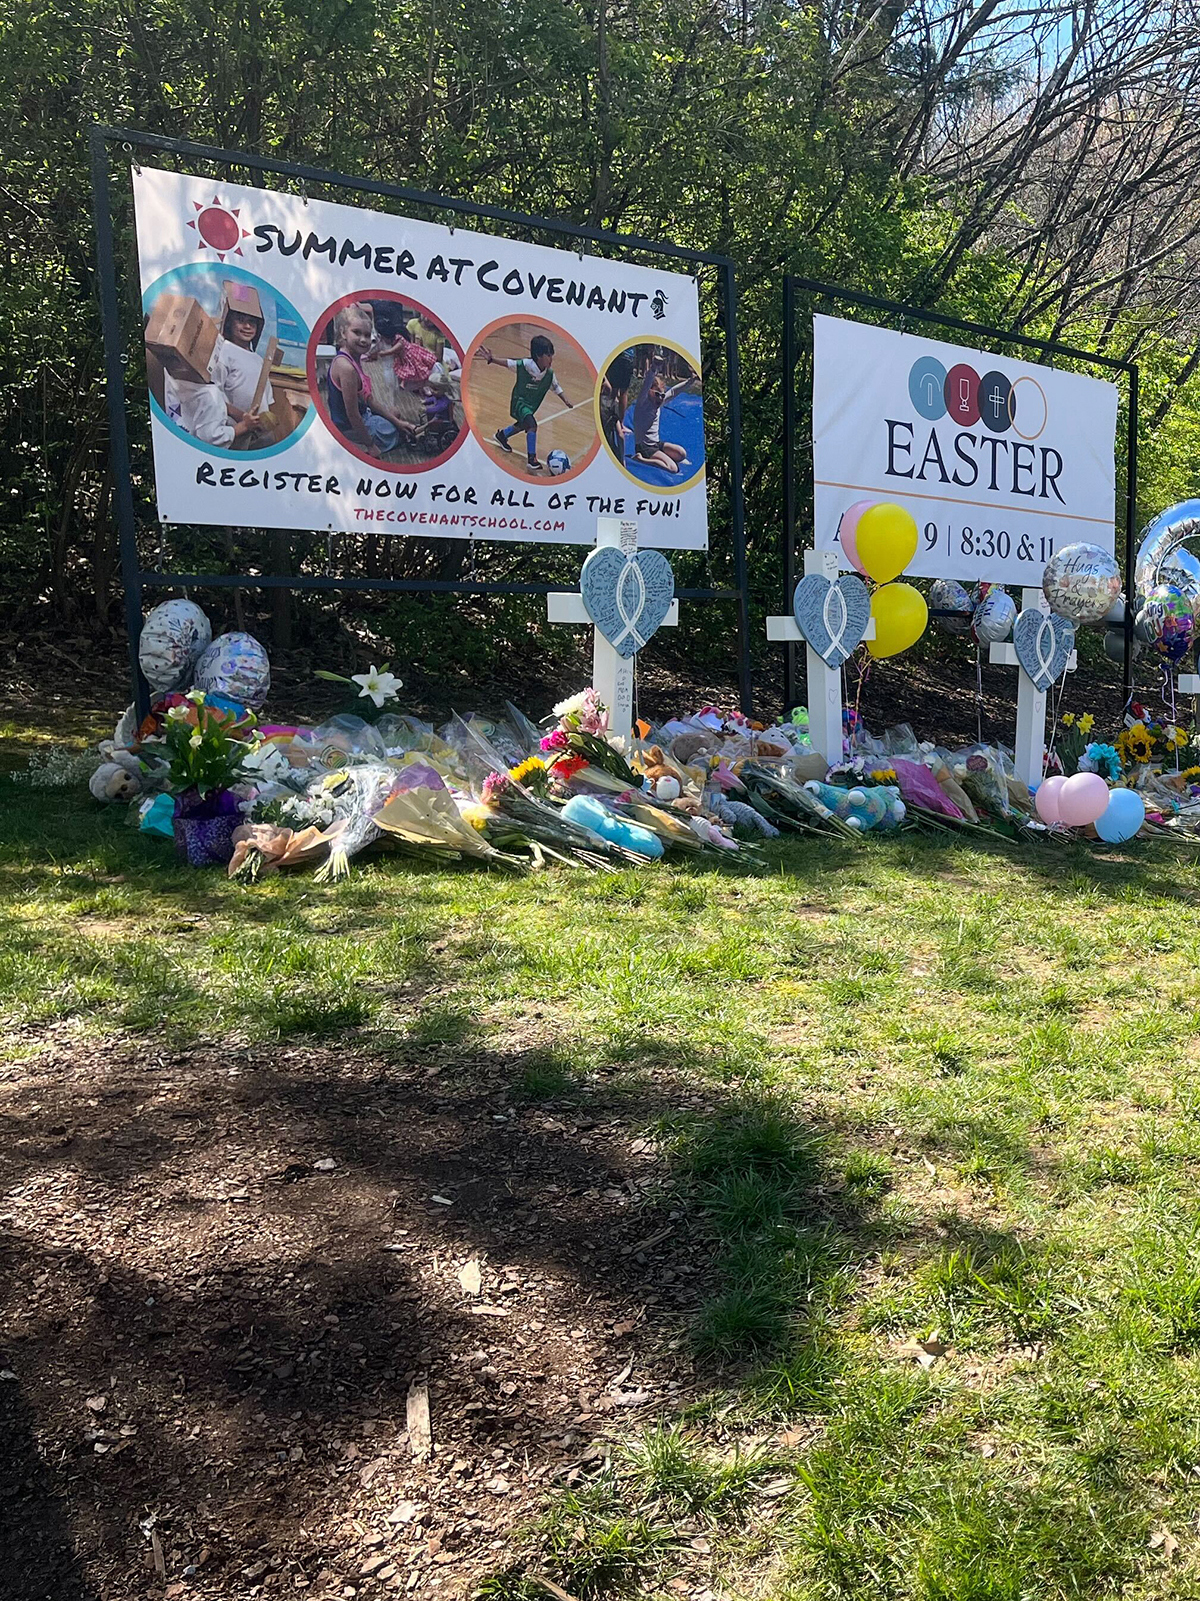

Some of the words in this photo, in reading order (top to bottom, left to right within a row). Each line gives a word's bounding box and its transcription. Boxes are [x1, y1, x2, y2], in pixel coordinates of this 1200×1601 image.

[254, 225, 418, 280] SUMMER
[426, 255, 474, 285] AT
[477, 260, 648, 317] COVENANT
[884, 419, 1067, 505] EASTER
[196, 462, 340, 495] REGISTER
[356, 478, 417, 500] NOW
[431, 484, 477, 505] FOR
[490, 489, 535, 508] ALL
[549, 493, 576, 511] OF
[586, 495, 625, 515] THE
[637, 499, 681, 519] FUN!
[354, 508, 565, 531] THECOVENANTSCHOOL.COM
[924, 522, 938, 551] 9
[960, 526, 1011, 559] 8:30
[1017, 533, 1035, 562] &
[1064, 556, 1099, 584] Hugs
[1051, 588, 1106, 616] Prayers
[1071, 580, 1082, 596] &
